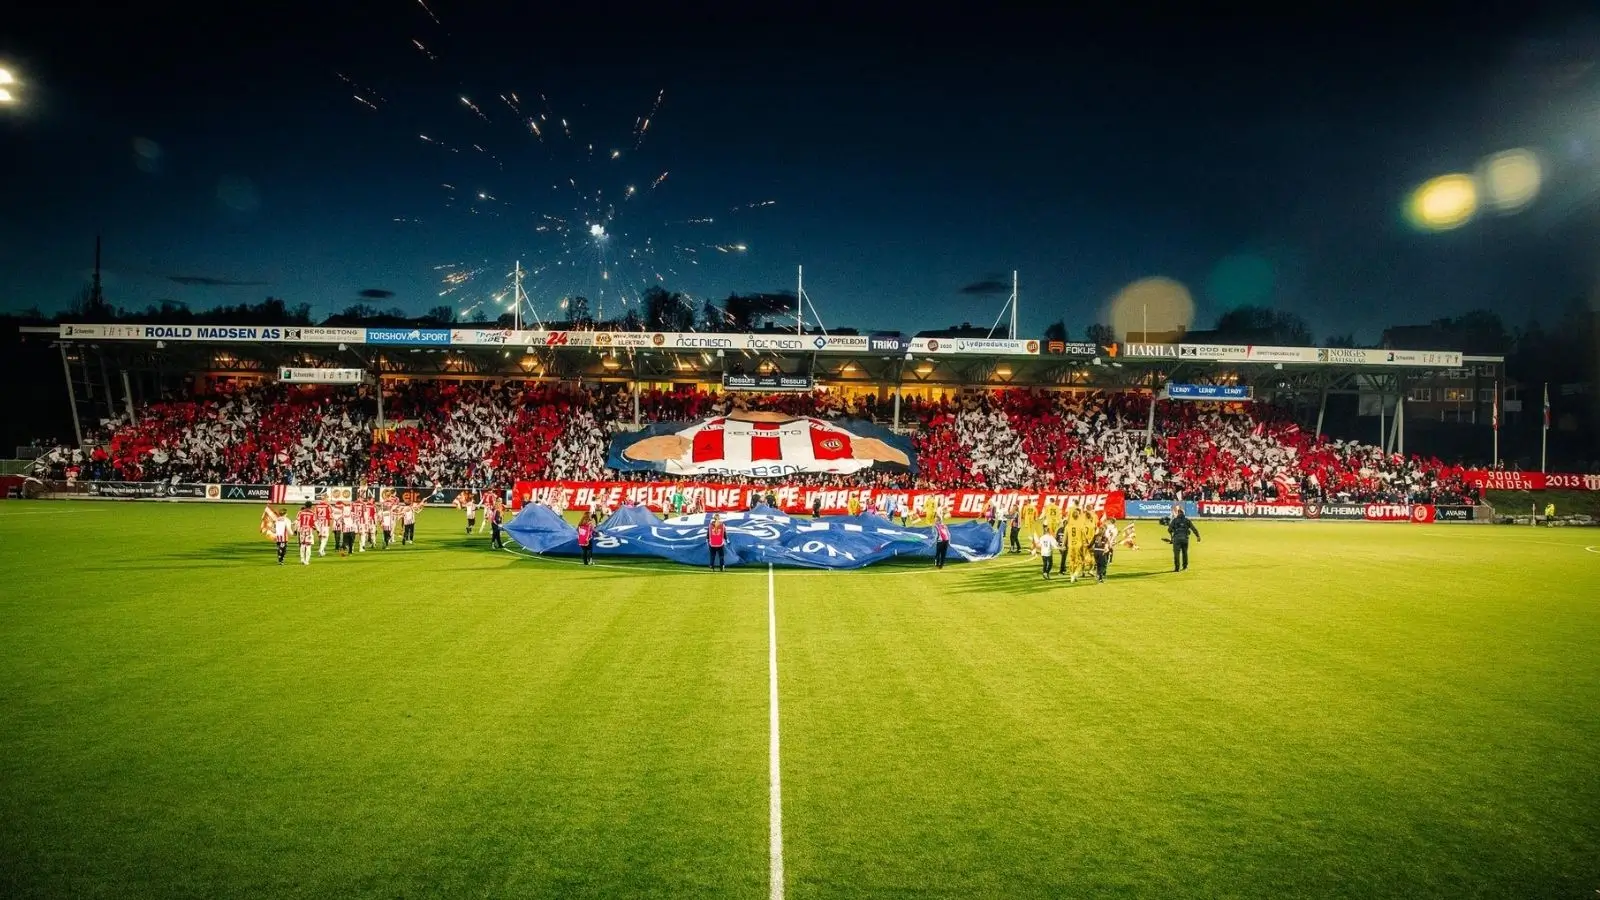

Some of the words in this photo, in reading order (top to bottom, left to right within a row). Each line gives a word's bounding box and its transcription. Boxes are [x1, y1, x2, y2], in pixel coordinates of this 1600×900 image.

[145, 327, 192, 338] ROALD
[197, 328, 257, 339] MADSEN
[261, 328, 280, 339] AS
[369, 331, 409, 340] TORSHOV
[421, 332, 448, 341] SPORT
[676, 334, 698, 347] ÅGE
[700, 338, 732, 347] NILSEN
[747, 335, 768, 348] ÅGE
[770, 339, 803, 349] NILSEN
[1065, 346, 1096, 355] FOKUS
[1126, 344, 1177, 357] HARILA
[1330, 348, 1366, 358] NORGES
[781, 377, 807, 385] Ressurs
[1545, 475, 1580, 487] 2013
[574, 487, 623, 507] ALLE
[876, 493, 909, 512] HR
[913, 493, 956, 512] RDE
[960, 493, 986, 513] OG
[1203, 504, 1244, 516] FORZA
[1367, 505, 1410, 518] GUTAN
